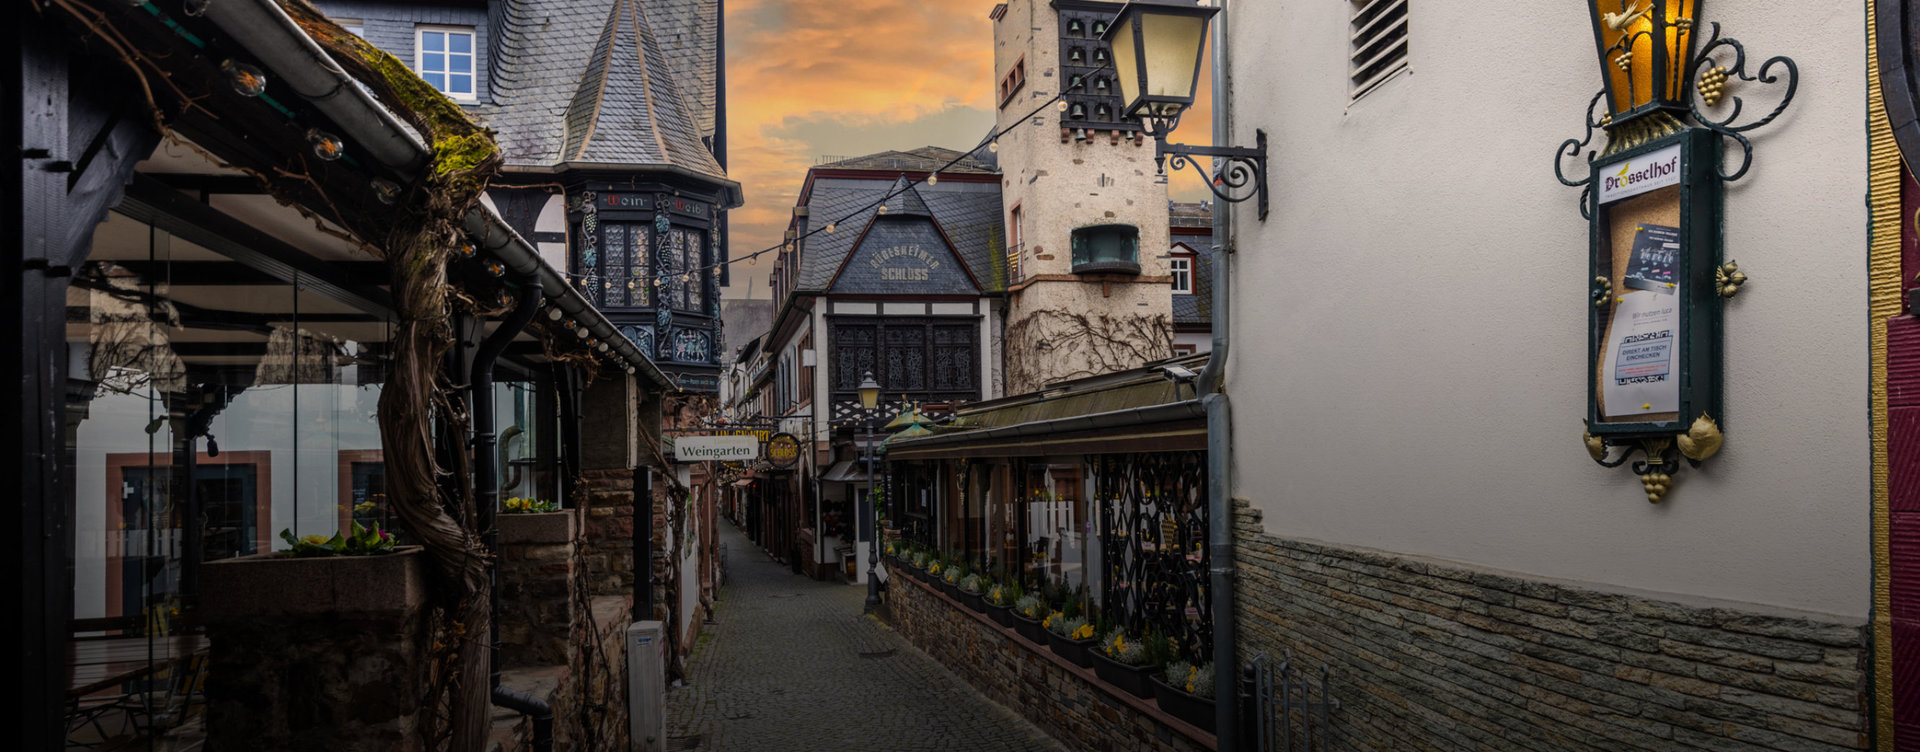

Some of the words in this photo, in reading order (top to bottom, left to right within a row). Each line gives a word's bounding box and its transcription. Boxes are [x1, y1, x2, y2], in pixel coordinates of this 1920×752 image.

[1605, 156, 1677, 192] Drosselhof
[1622, 348, 1641, 356] DIREKT
[1651, 344, 1667, 352] TISCH
[1626, 352, 1660, 361] EINCHECKEN
[682, 446, 750, 458] Weingarten
